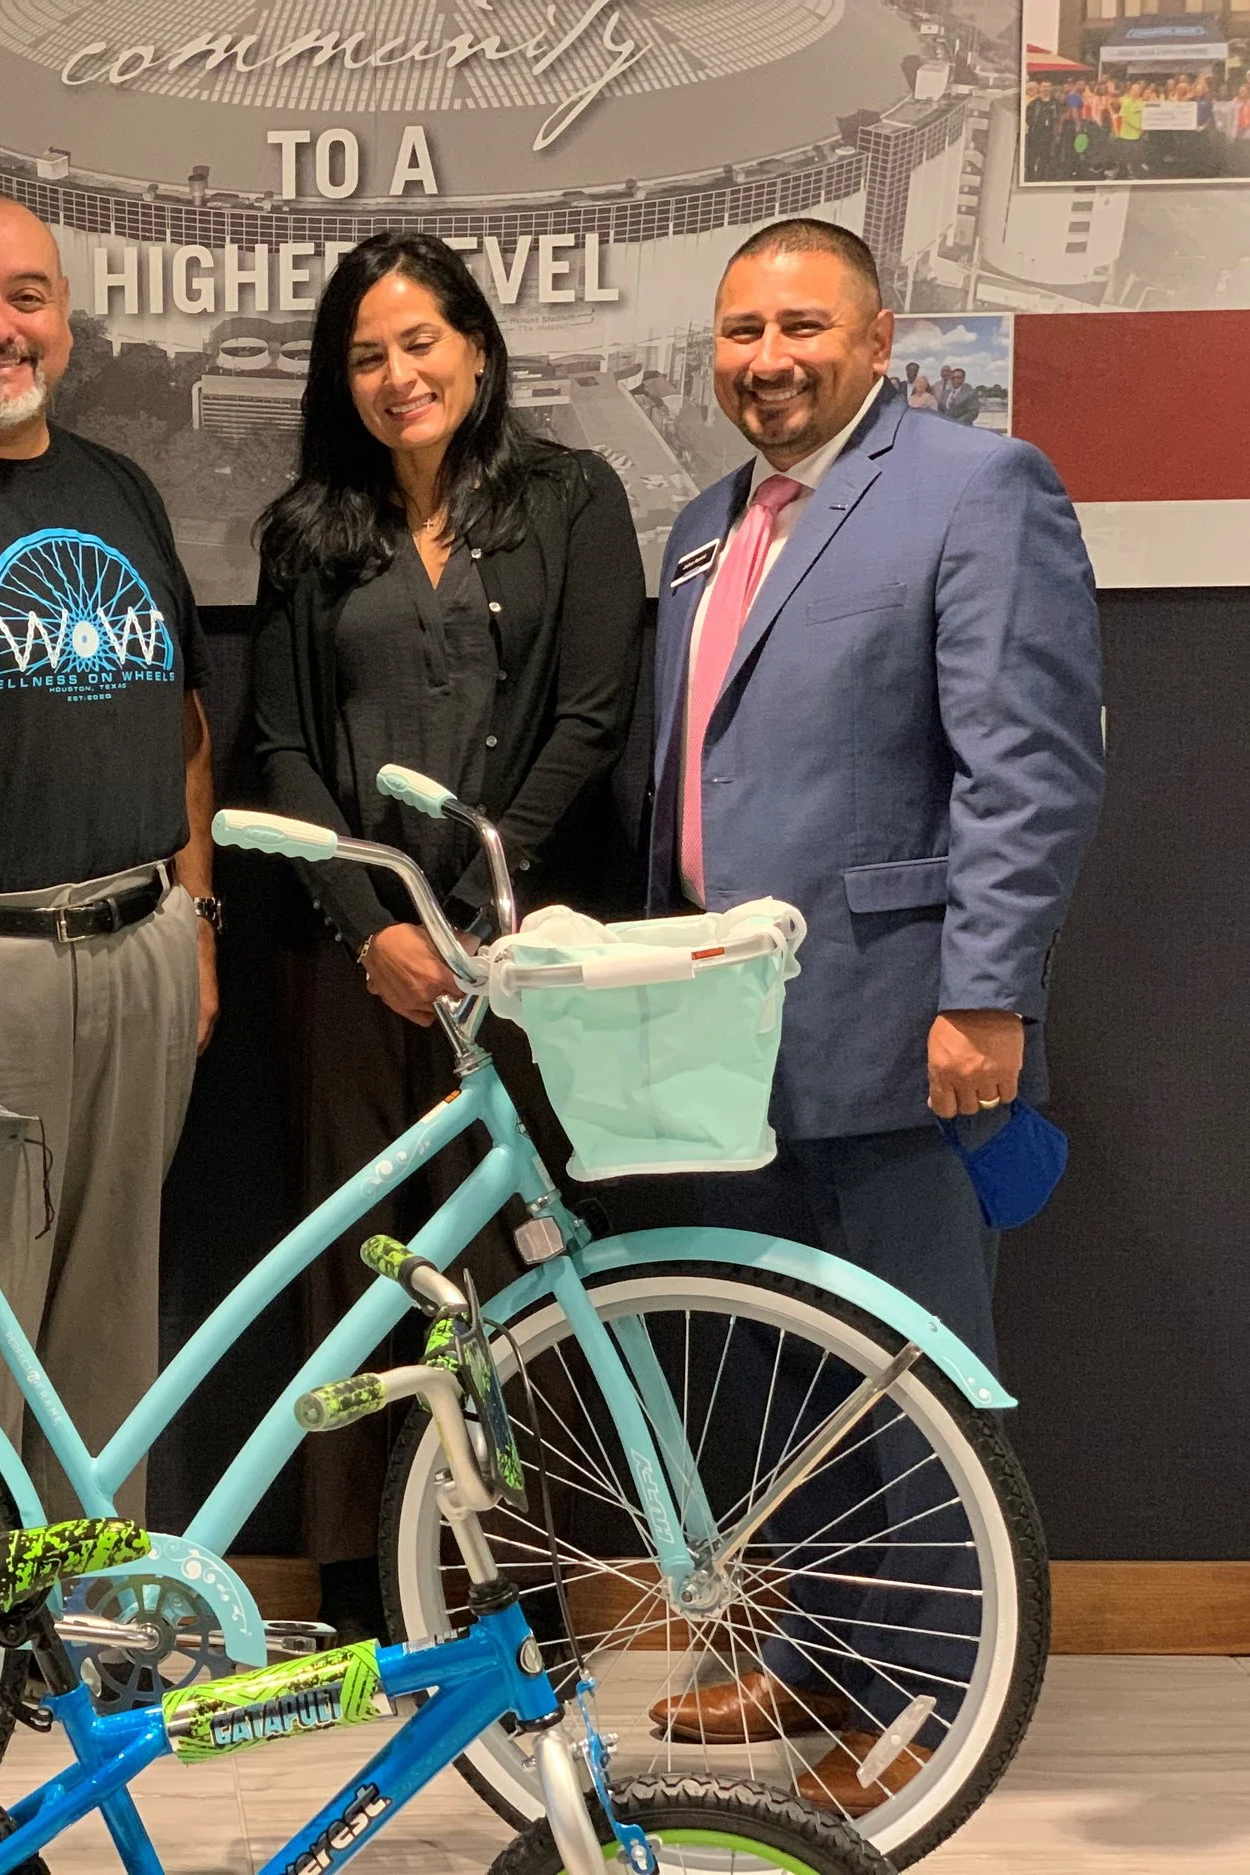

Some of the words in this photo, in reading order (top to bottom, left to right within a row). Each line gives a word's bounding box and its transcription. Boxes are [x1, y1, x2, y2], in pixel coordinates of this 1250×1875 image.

[61, 0, 653, 151] community
[267, 130, 358, 200] TO
[389, 126, 438, 196] A
[442, 234, 619, 305] VEL
[88, 672, 113, 684] ON
[122, 671, 175, 682] WHEELS
[630, 1448, 675, 1544] HUFFY
[211, 1681, 344, 1745] CATAPULT
